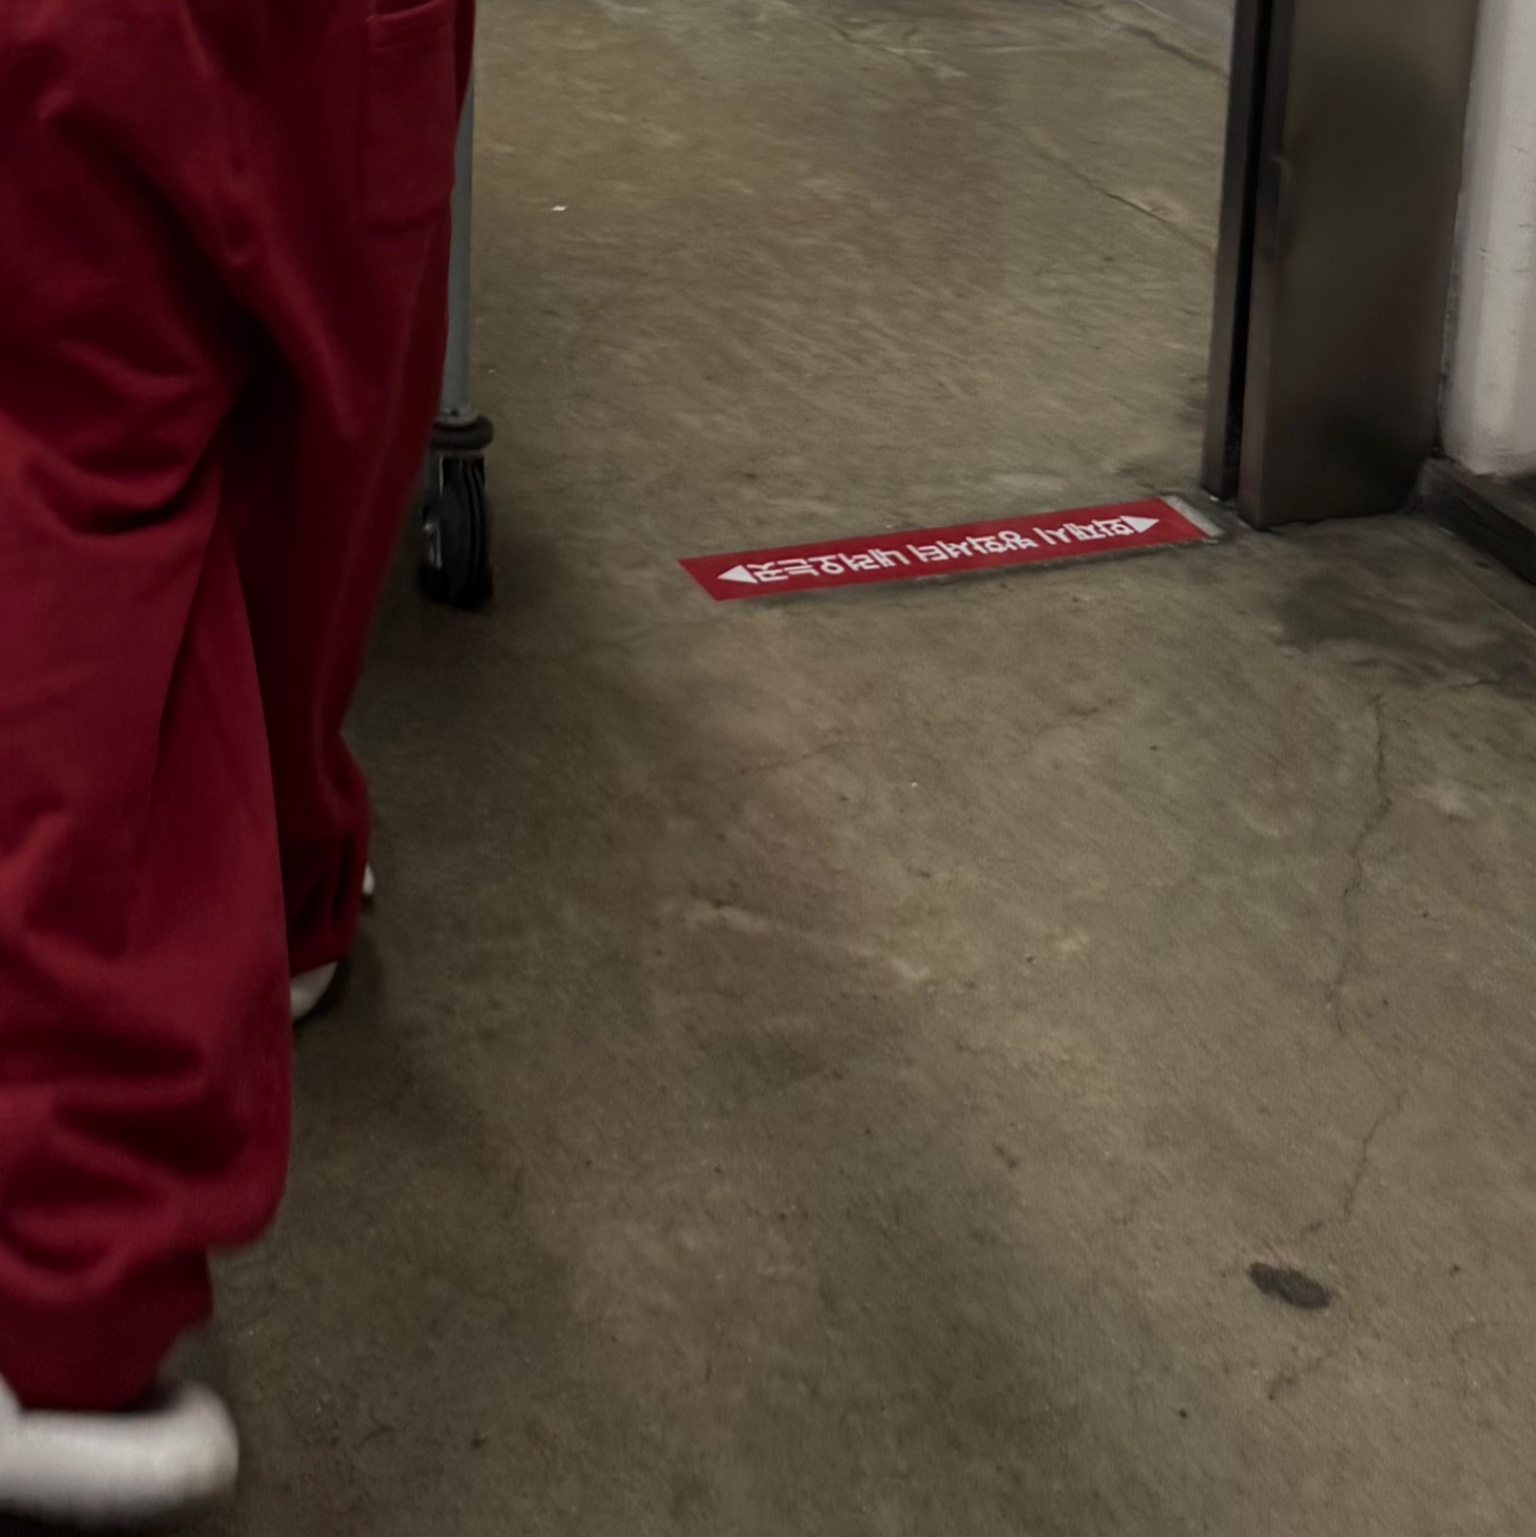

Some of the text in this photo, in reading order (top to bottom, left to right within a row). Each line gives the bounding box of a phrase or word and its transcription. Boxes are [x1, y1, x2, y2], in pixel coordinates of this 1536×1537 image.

[746, 518, 1135, 582] 화재시 방화셔터 내려오는곳
